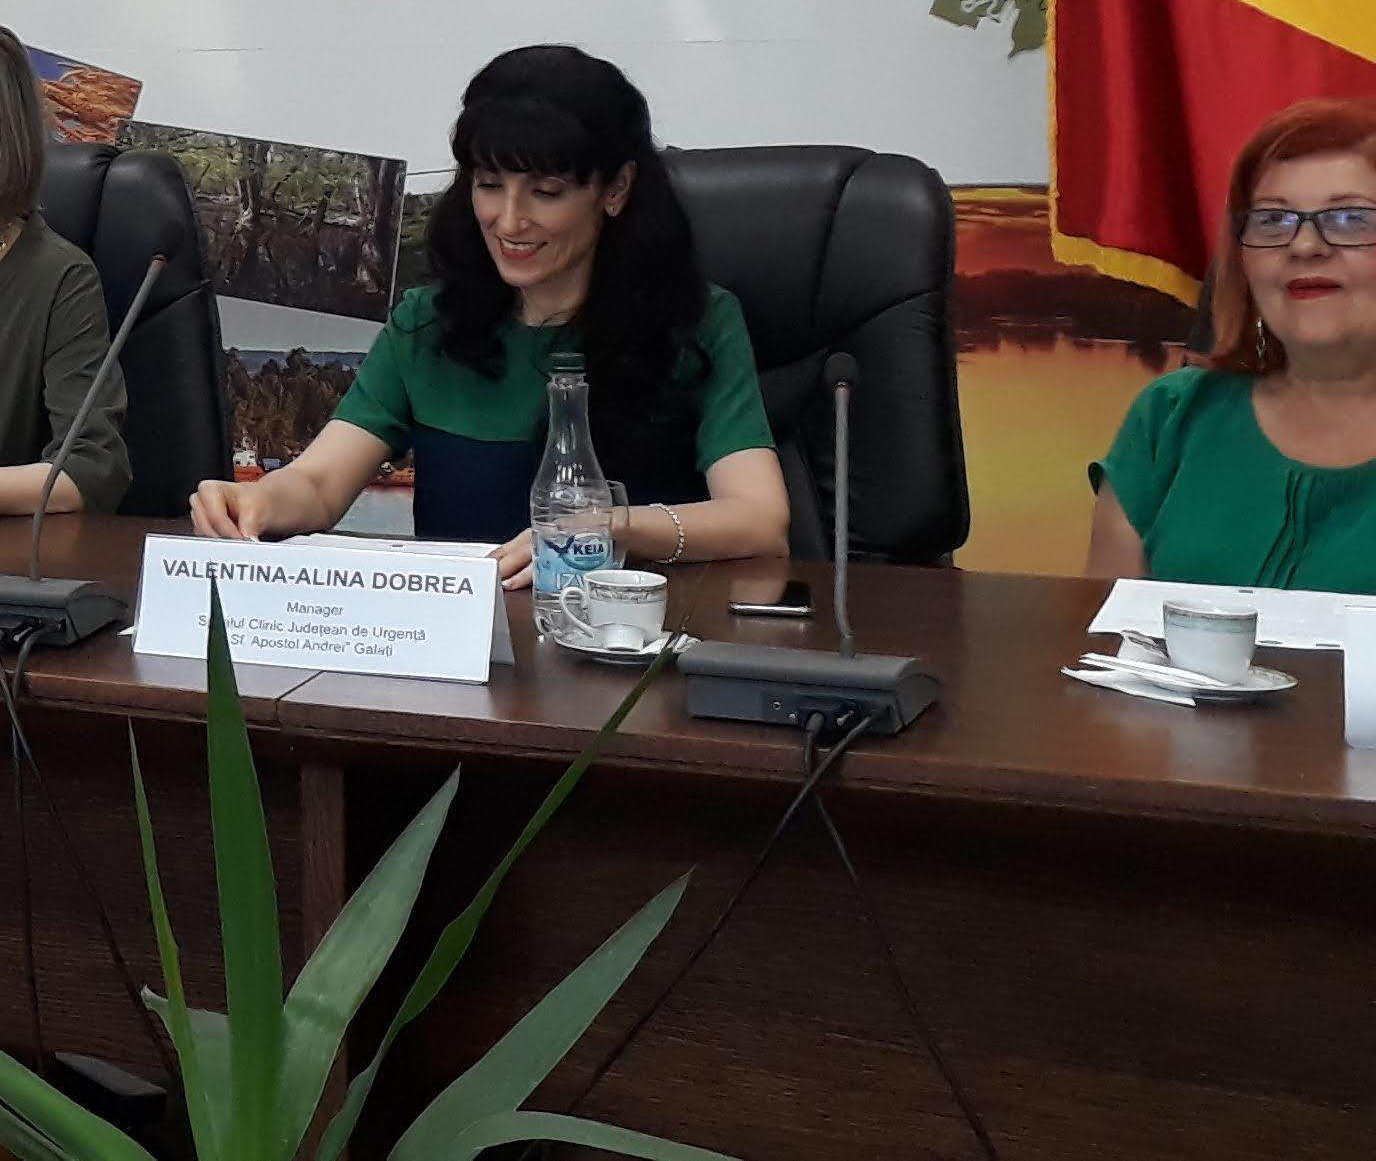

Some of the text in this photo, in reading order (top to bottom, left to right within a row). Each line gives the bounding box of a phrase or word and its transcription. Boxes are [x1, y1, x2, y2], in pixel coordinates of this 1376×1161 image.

[573, 543, 605, 556] KEIA
[162, 558, 475, 596] VALENTINA-ALINA DOBREA
[286, 601, 344, 618] Manager
[248, 618, 283, 632] Clinic
[351, 624, 368, 637] de
[251, 635, 298, 650] Apostol
